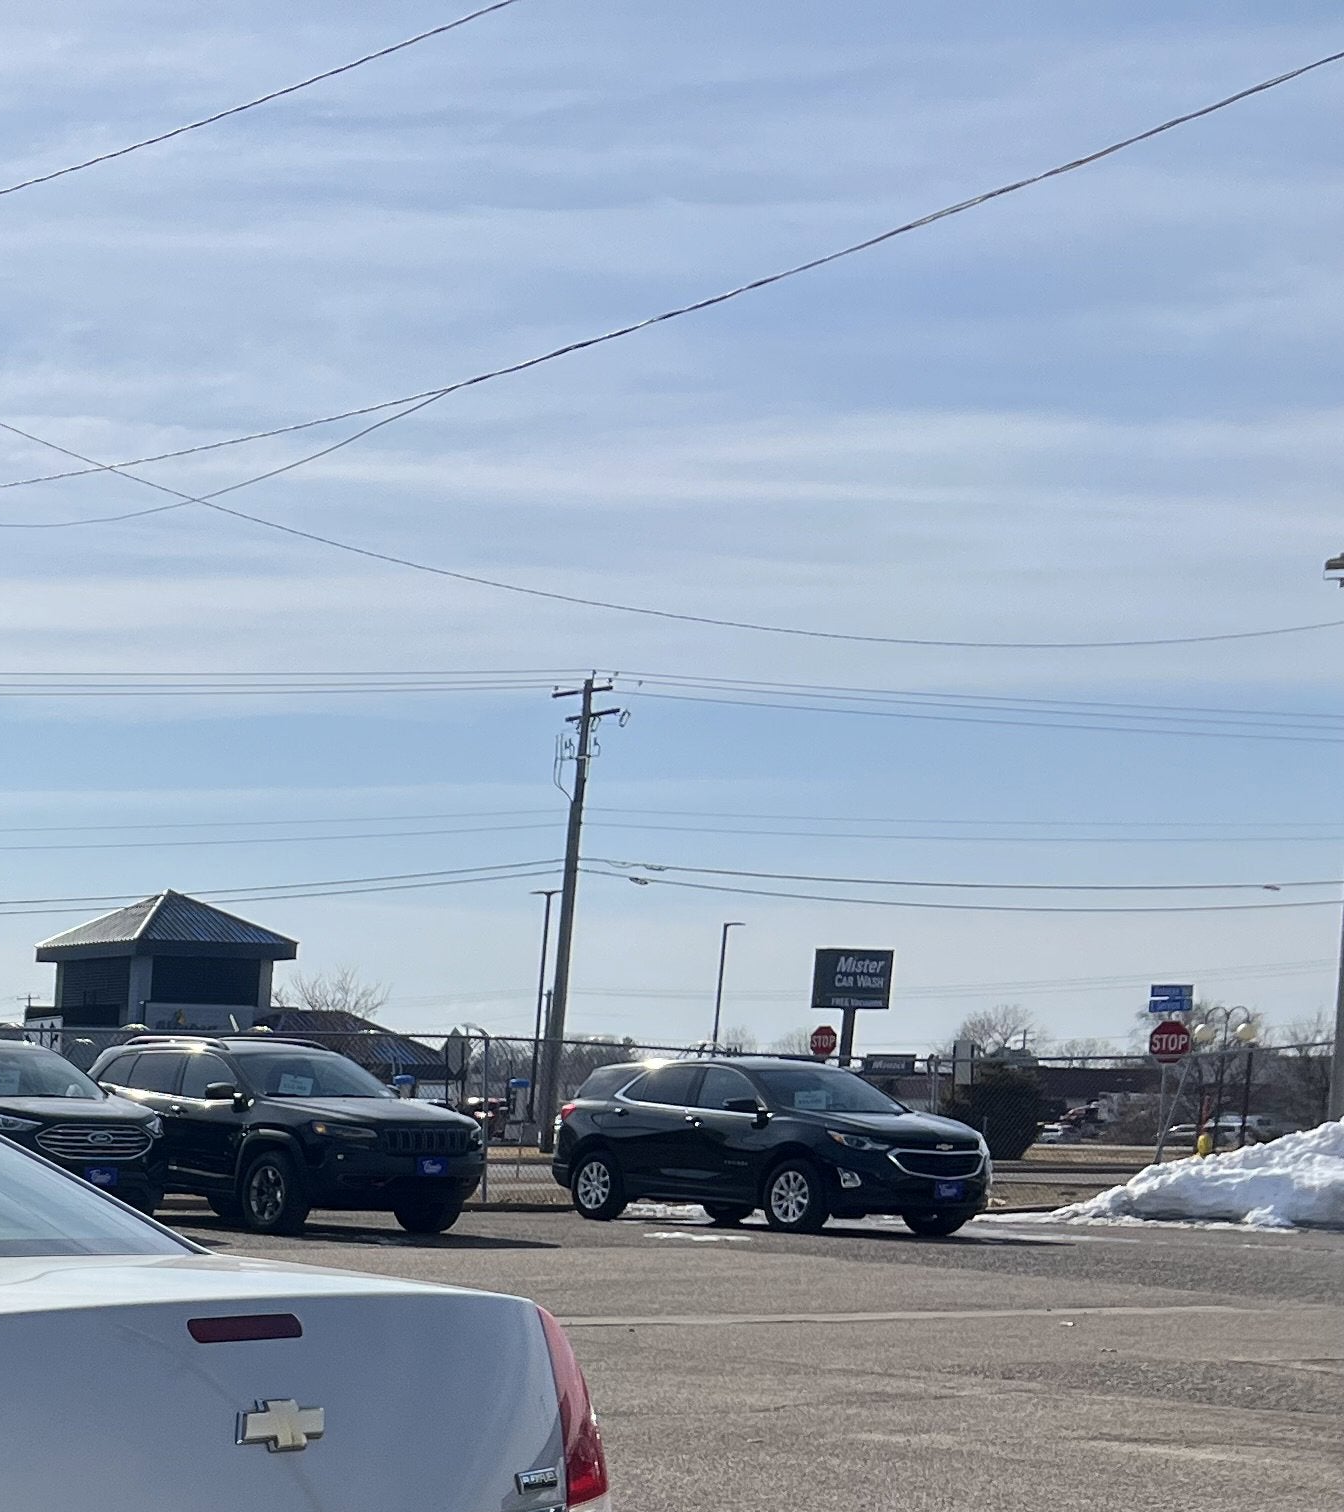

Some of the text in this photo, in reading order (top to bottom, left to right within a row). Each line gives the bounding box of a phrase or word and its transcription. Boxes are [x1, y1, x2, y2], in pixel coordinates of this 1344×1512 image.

[837, 956, 886, 973] Mister
[835, 974, 884, 988] CAR WASH
[811, 1035, 836, 1048] STOP
[1152, 1034, 1188, 1051] STOP
